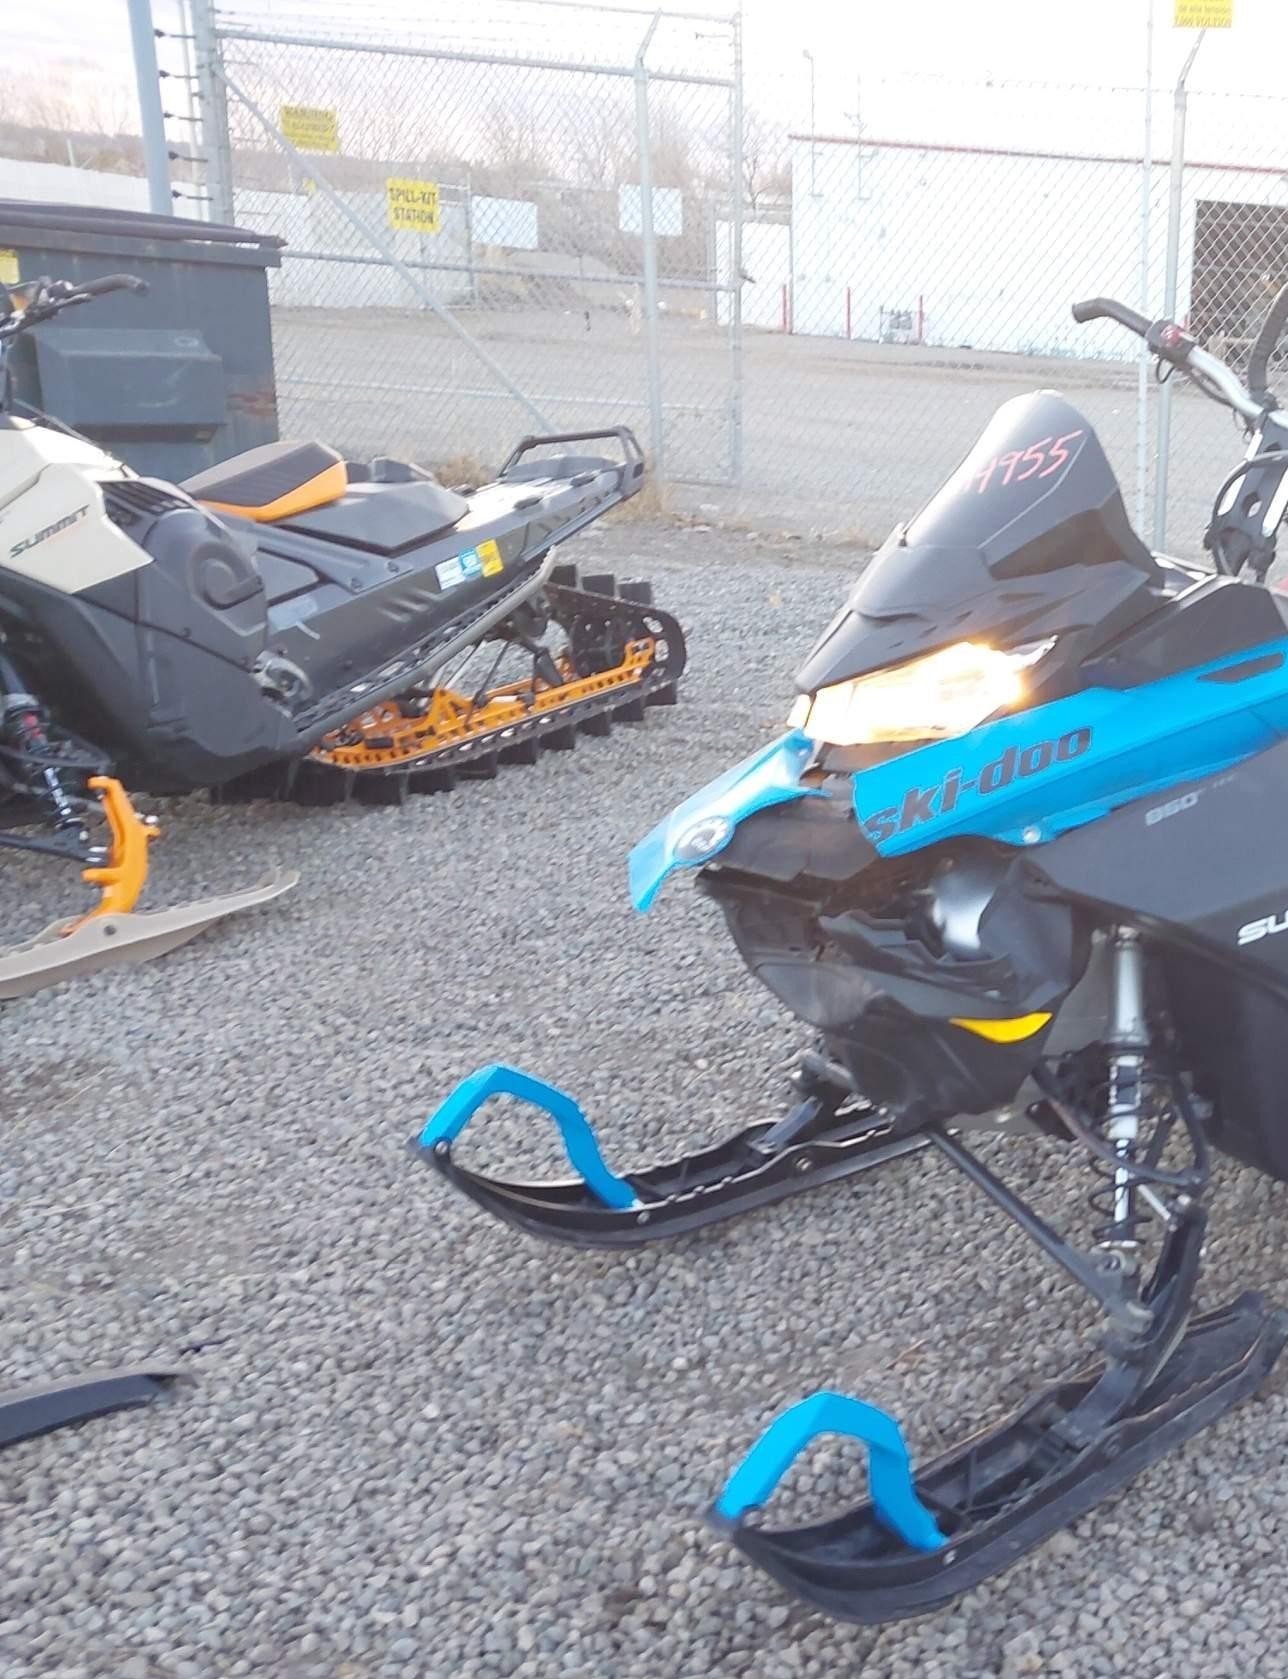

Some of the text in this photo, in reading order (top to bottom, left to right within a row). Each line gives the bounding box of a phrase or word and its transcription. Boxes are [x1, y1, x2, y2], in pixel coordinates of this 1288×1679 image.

[393, 206, 434, 224] STATION
[10, 504, 90, 558] SUMMIT
[864, 727, 1093, 844] ski-doo
